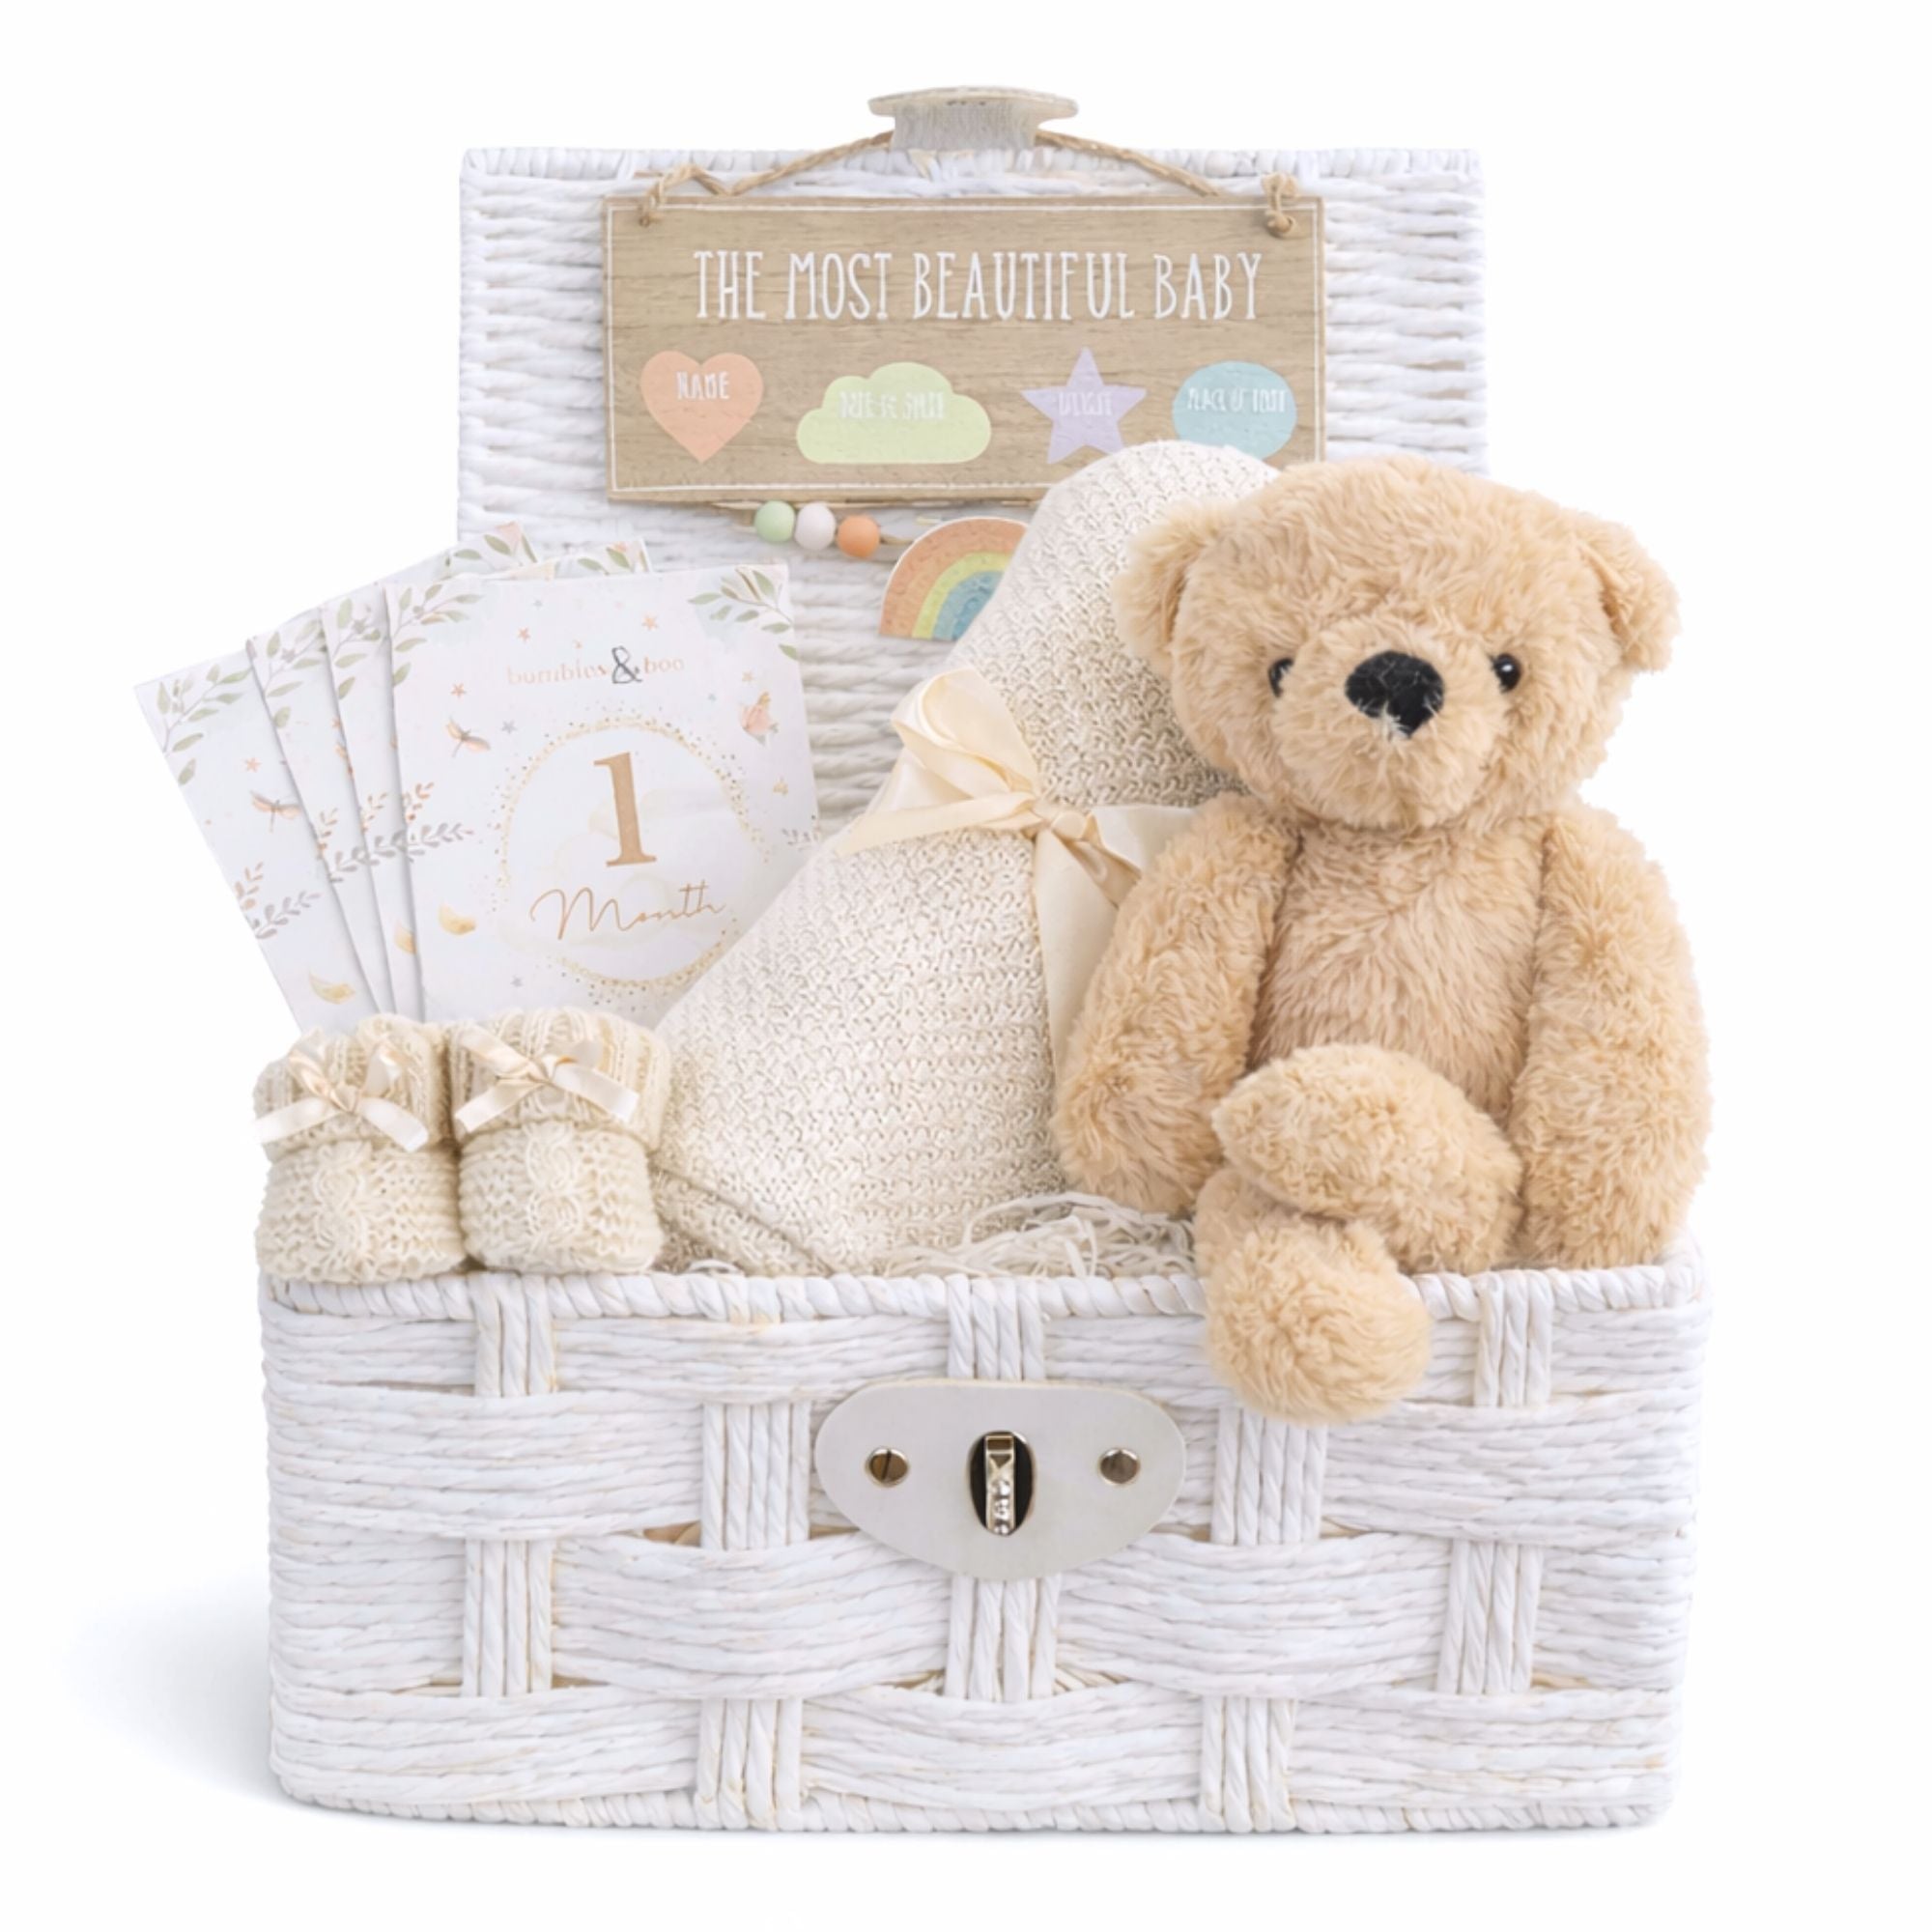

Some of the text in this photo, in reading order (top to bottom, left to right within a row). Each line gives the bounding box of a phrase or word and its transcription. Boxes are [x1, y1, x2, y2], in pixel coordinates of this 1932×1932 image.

[694, 250, 1263, 320] THE MOST BEAUTIFUL BABY
[593, 752, 657, 867] 1
[529, 879, 727, 941] Month
